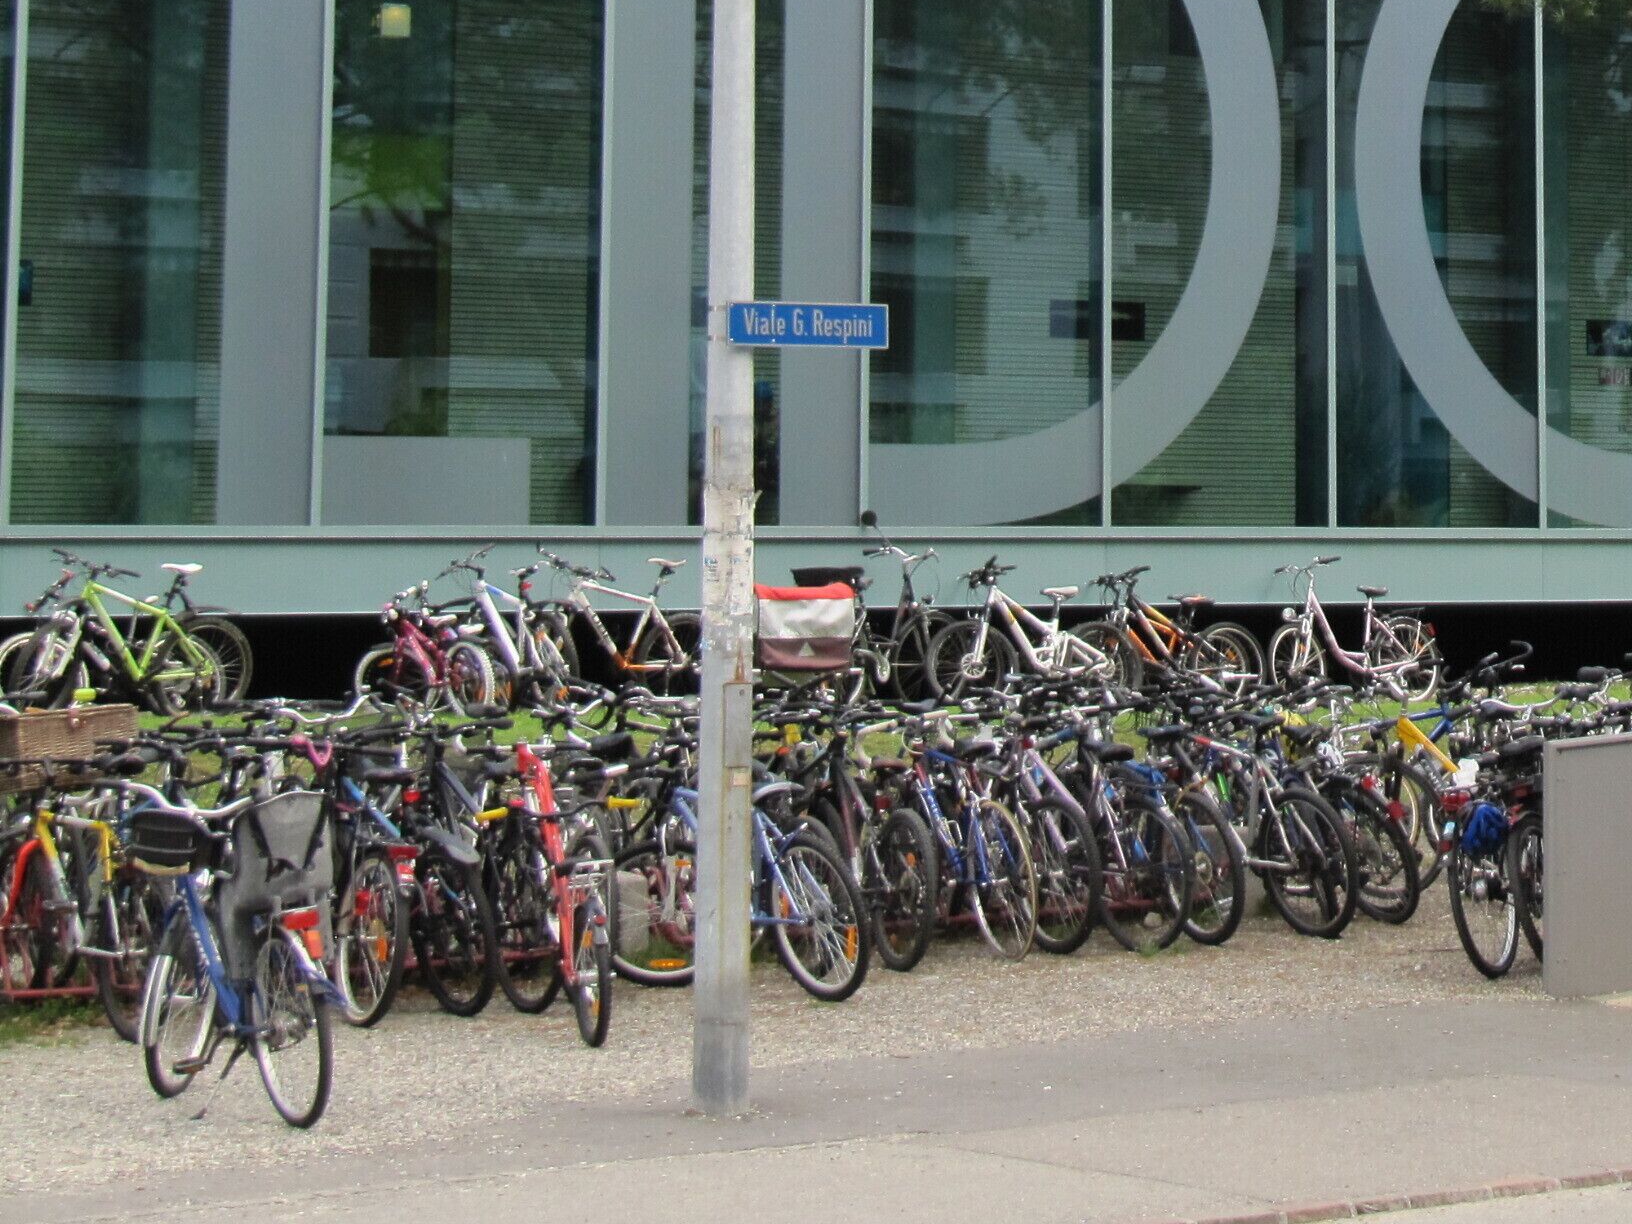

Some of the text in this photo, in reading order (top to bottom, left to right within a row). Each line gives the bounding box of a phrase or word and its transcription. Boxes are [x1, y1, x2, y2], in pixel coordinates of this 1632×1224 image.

[744, 308, 872, 343] Viale G. Respini
